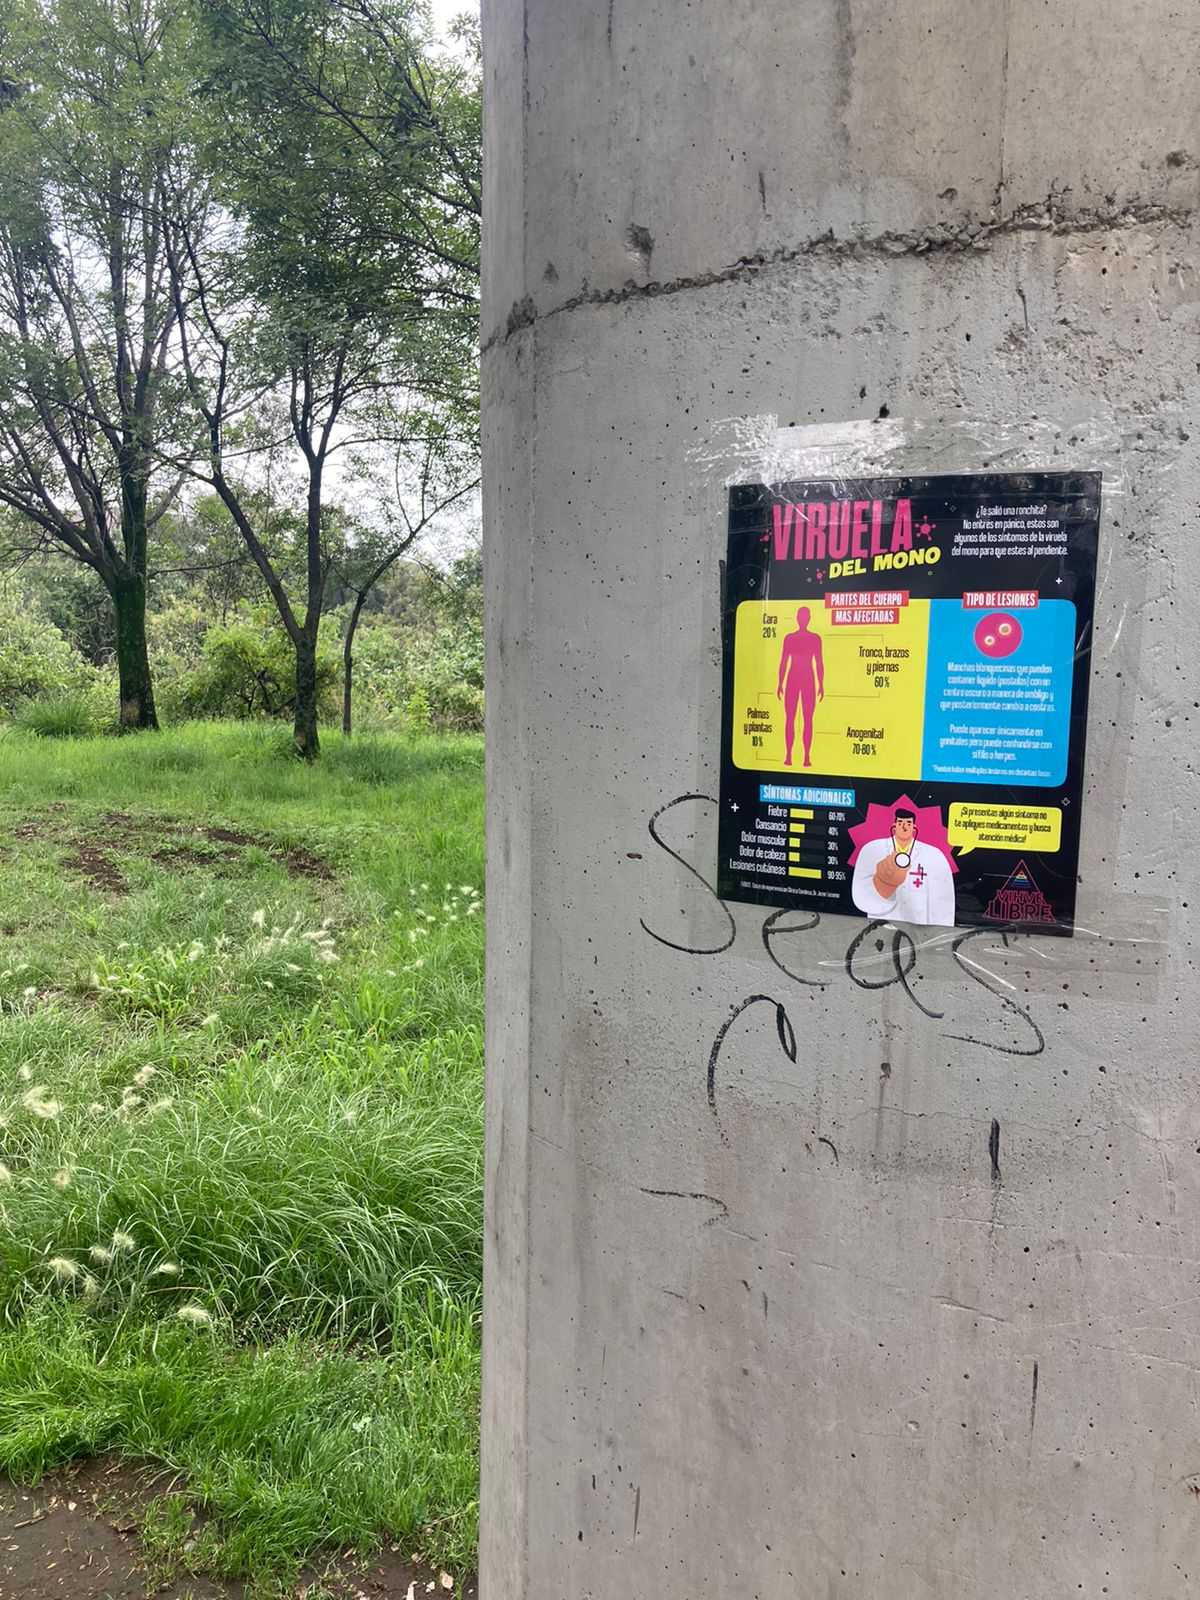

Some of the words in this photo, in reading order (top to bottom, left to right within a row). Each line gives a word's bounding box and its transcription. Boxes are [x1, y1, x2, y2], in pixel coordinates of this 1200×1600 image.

[1003, 507, 1015, 516] una
[1016, 504, 1048, 515] ronchita?
[772, 499, 913, 560] VIRUELA
[963, 520, 971, 529] No
[972, 520, 993, 529] entres
[995, 521, 1002, 529] en
[1027, 520, 1046, 529] estos
[1047, 521, 1059, 529] son
[954, 533, 978, 545] algunos
[980, 532, 986, 542] de
[988, 532, 997, 542] los
[1030, 532, 1037, 541] de
[1038, 532, 1044, 541] la
[1045, 532, 1068, 542] viruela
[952, 546, 961, 556] del
[962, 548, 979, 556] mono
[980, 548, 994, 559] para
[995, 548, 1007, 559] que
[1027, 545, 1033, 555] al
[1034, 545, 1068, 558] pendiente.
[829, 559, 866, 579] DEL
[873, 546, 941, 571] MONO
[831, 592, 858, 606] PARTES
[859, 592, 872, 605] DEL
[873, 591, 901, 605] CUERPO
[966, 592, 984, 606] TIPO
[986, 592, 997, 606] DE
[999, 591, 1036, 606] LESIONES
[763, 613, 778, 624] Cara
[835, 610, 853, 623] MAS
[853, 609, 894, 623] AFECTADAS
[859, 646, 884, 660] Tronco,
[885, 646, 910, 658] brazos
[866, 663, 871, 675] y
[872, 661, 899, 675] piernas
[747, 708, 770, 719] Palmas
[744, 723, 748, 735] y
[748, 721, 773, 735] plantas
[847, 727, 884, 742] Anogenital
[763, 784, 801, 801] SÍNTOMAS
[803, 788, 852, 805] ADICIONALES
[768, 804, 787, 817] Fiebre
[968, 808, 998, 818] presentas
[755, 818, 787, 831] Cansancio
[954, 819, 962, 828] te
[986, 821, 1028, 831] medicamentos
[1029, 824, 1033, 834] y
[1034, 823, 1051, 833] busca
[741, 831, 756, 843] Dolor
[757, 835, 787, 847] muscular
[739, 845, 754, 857] Dolor
[755, 847, 763, 858] de
[764, 848, 786, 861] cabeza
[730, 858, 756, 871] Lesiones
[756, 862, 786, 875] cutáneas
[989, 900, 1053, 922] LIBRE
